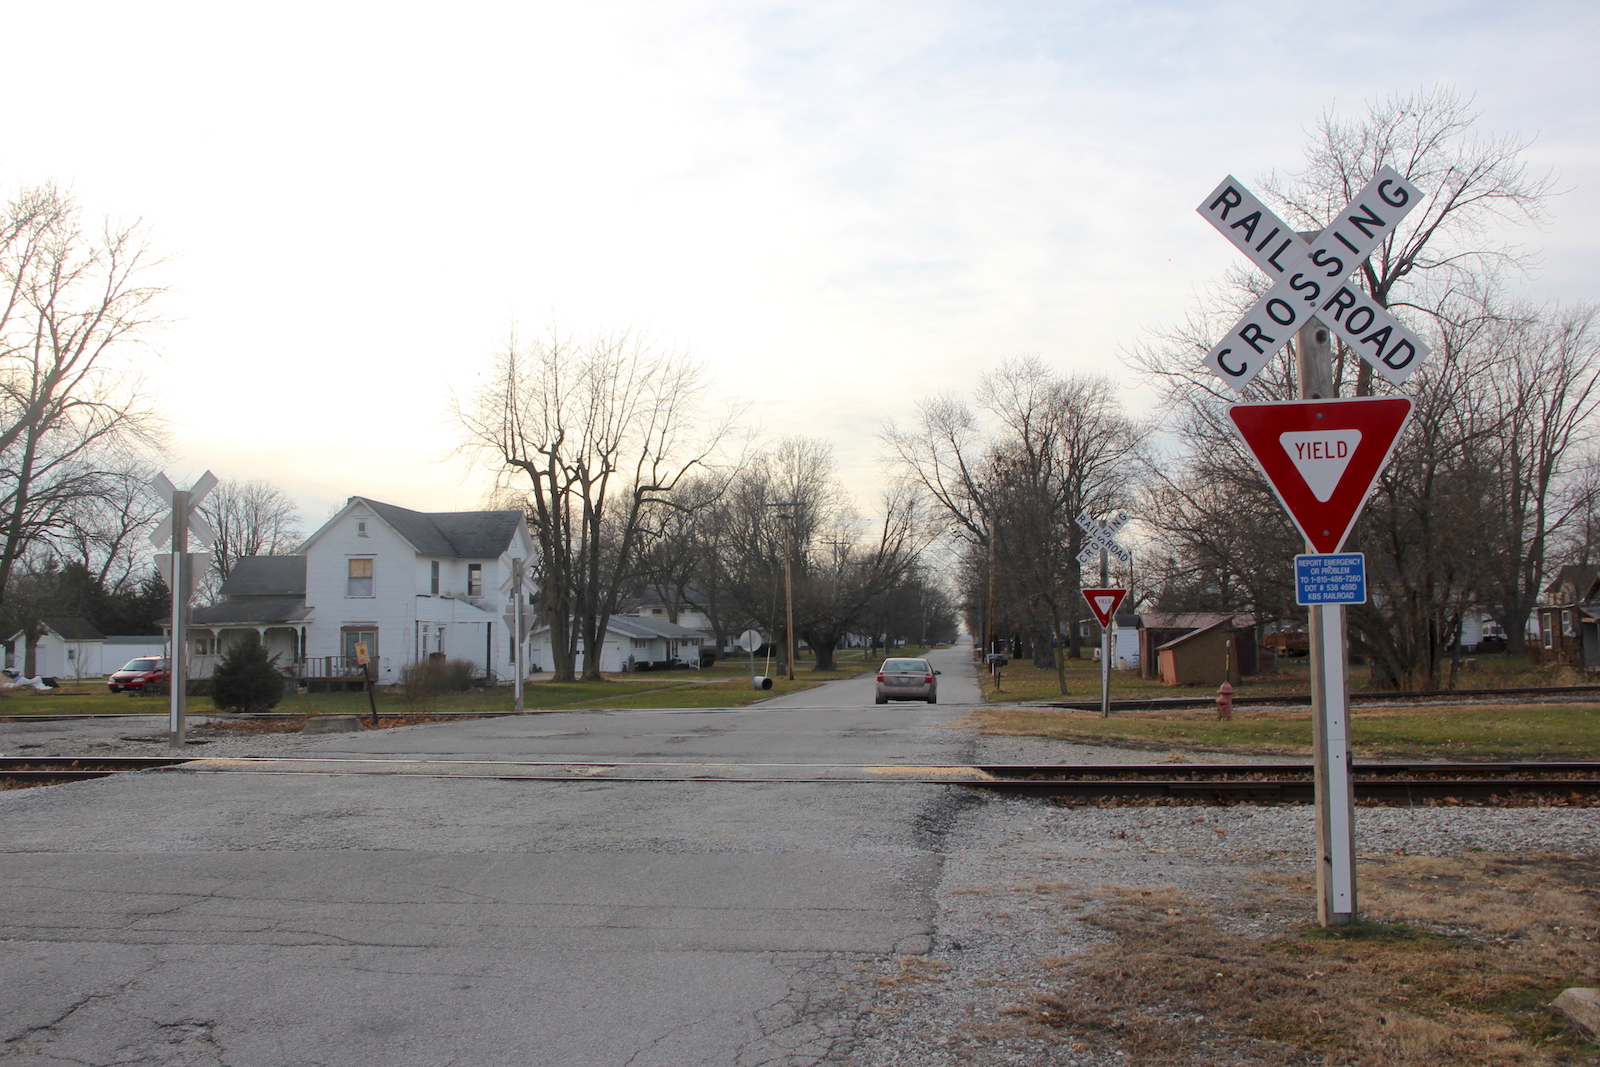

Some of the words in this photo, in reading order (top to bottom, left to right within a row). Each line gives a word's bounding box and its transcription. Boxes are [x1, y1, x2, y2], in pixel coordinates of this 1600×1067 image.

[1208, 184, 1293, 274] RAIL
[1322, 285, 1416, 370] ROAD
[1216, 179, 1410, 378] CROSSING
[1294, 440, 1348, 460] YIELD
[1077, 514, 1099, 538] RAIL
[1104, 539, 1128, 563] ROAD
[1079, 512, 1127, 563] CROSSING
[1298, 559, 1322, 567] REPORT
[1323, 558, 1361, 566] EMERGENCY
[1310, 567, 1320, 575] OR
[1321, 567, 1350, 575] PROBLEM
[1299, 576, 1309, 584] TO
[1304, 584, 1317, 592] DOT
[1307, 592, 1321, 600] KBS
[1323, 591, 1354, 599] RAILROAD
